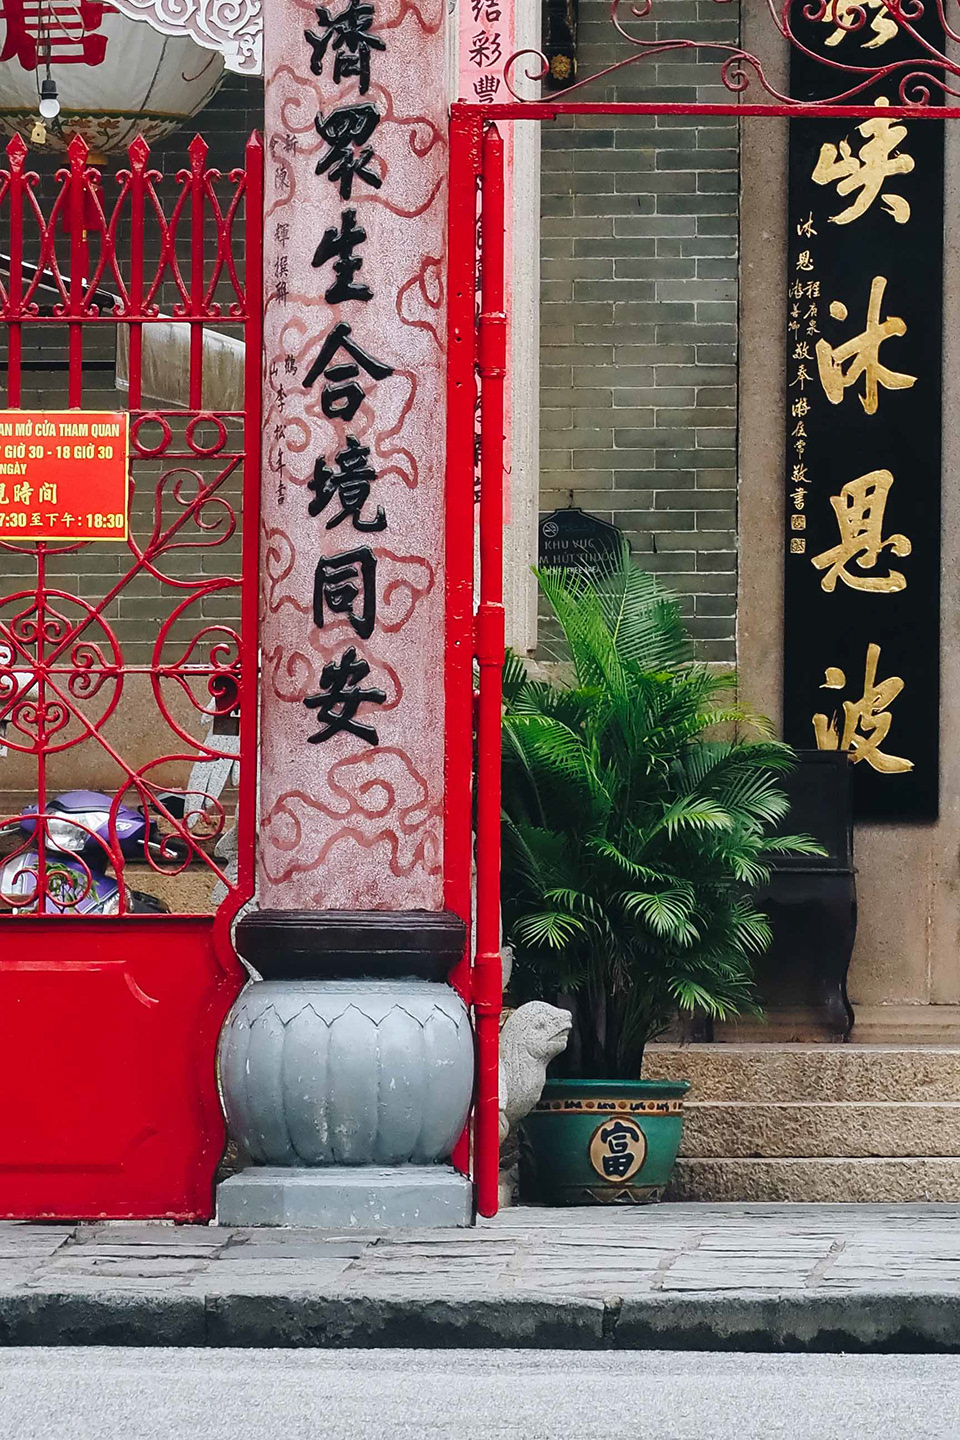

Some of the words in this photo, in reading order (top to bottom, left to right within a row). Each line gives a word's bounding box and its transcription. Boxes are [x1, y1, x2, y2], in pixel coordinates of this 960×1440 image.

[15, 420, 33, 437] MỞ
[35, 420, 56, 437] CỬA
[59, 424, 88, 437] THAM
[91, 424, 119, 438] QUAN
[5, 443, 26, 458] GIỜ
[28, 446, 44, 458] 30
[56, 446, 70, 458] 18
[74, 443, 96, 458] GIỜ
[98, 446, 113, 459] 30
[0, 462, 27, 475] NGÀY
[545, 540, 569, 550] KHU
[601, 1121, 640, 1178] 富
